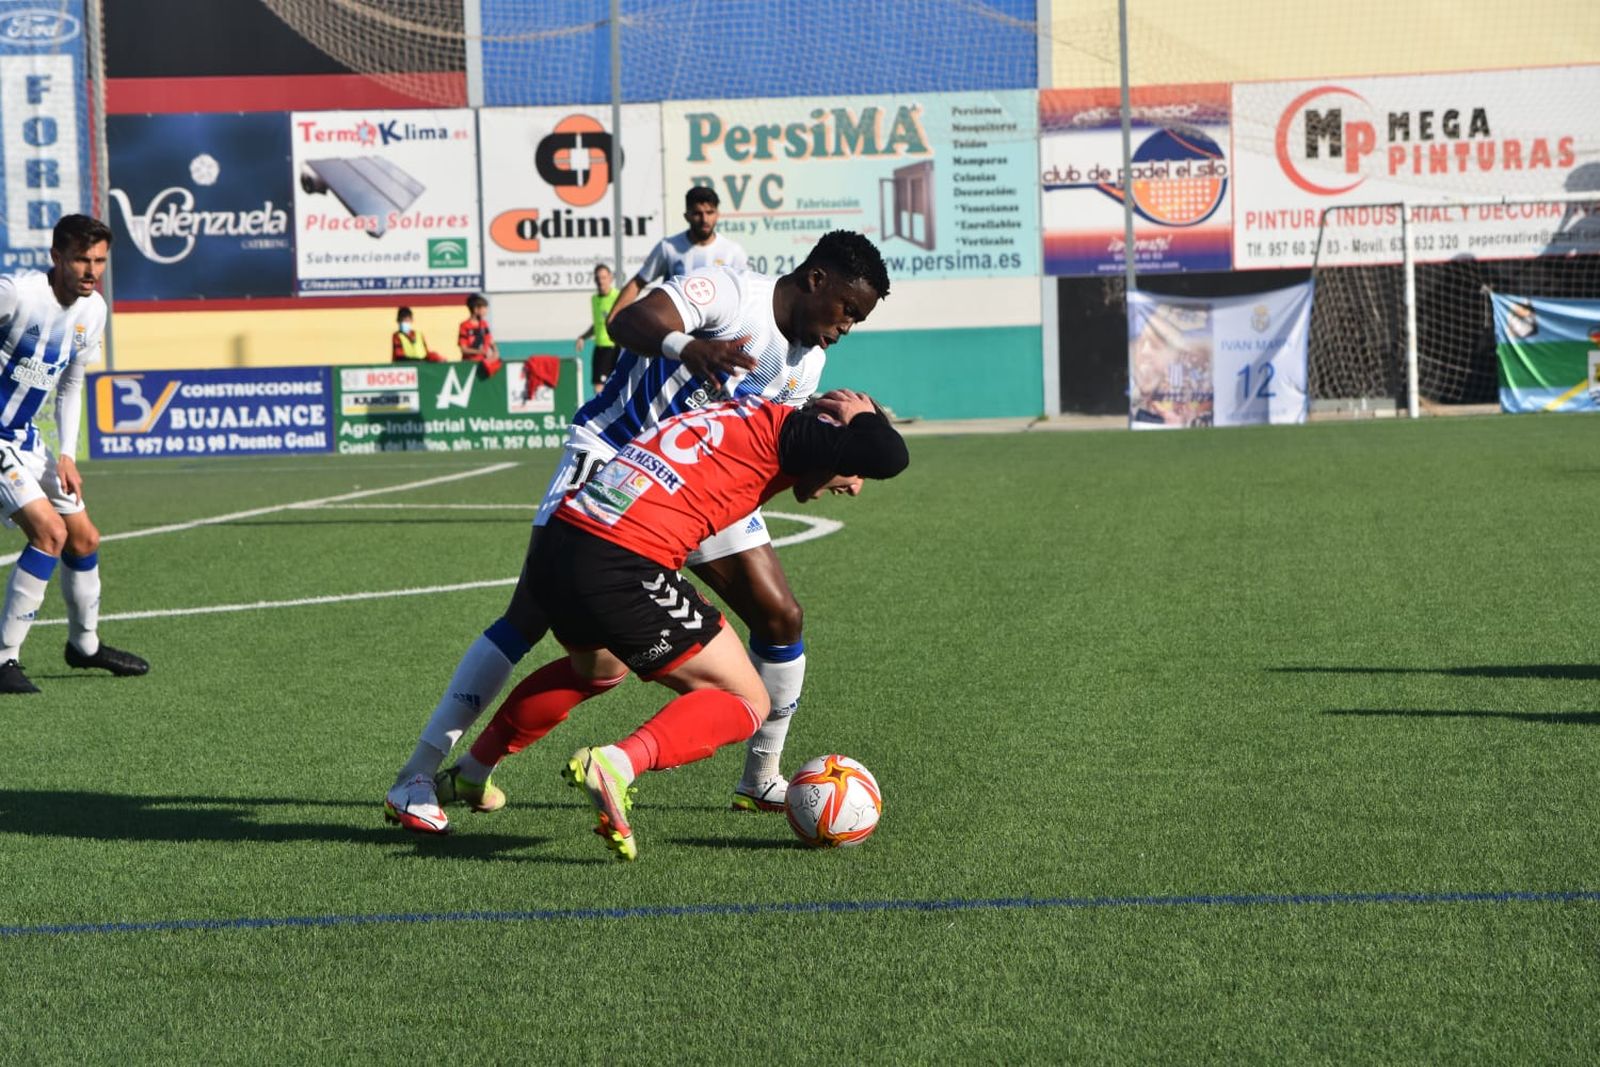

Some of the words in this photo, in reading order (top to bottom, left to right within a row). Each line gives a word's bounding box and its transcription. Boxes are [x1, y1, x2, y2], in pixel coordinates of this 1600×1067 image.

[685, 106, 932, 163] PersiMA
[1388, 107, 1490, 142] MEGA
[1388, 136, 1576, 176] PINTURAS
[1043, 163, 1081, 182] club
[1087, 162, 1111, 181] de
[1176, 157, 1191, 179] el
[1195, 157, 1227, 176] silo
[109, 187, 288, 264] Valenzuela
[305, 214, 377, 231] Placas
[387, 211, 469, 229] Solares
[715, 219, 746, 233] rtas
[750, 220, 759, 235] y
[763, 216, 831, 232] Ventanas
[1245, 208, 1328, 231] PINTURA
[1336, 203, 1453, 226] INDUSRIAL
[306, 251, 421, 265] Subvencionado
[532, 272, 561, 287] 902
[566, 271, 593, 286] 107
[181, 380, 323, 398] CONSTRUCCIONES
[367, 372, 417, 386] BOSCH
[1237, 361, 1277, 399] 12
[170, 404, 326, 430] BUJALANCE
[340, 416, 465, 437] Agro-Industrial
[469, 417, 539, 434] Velasco,
[135, 435, 164, 454] 957
[165, 435, 184, 452] 60
[228, 432, 282, 451] Puente
[284, 431, 326, 449] Genil
